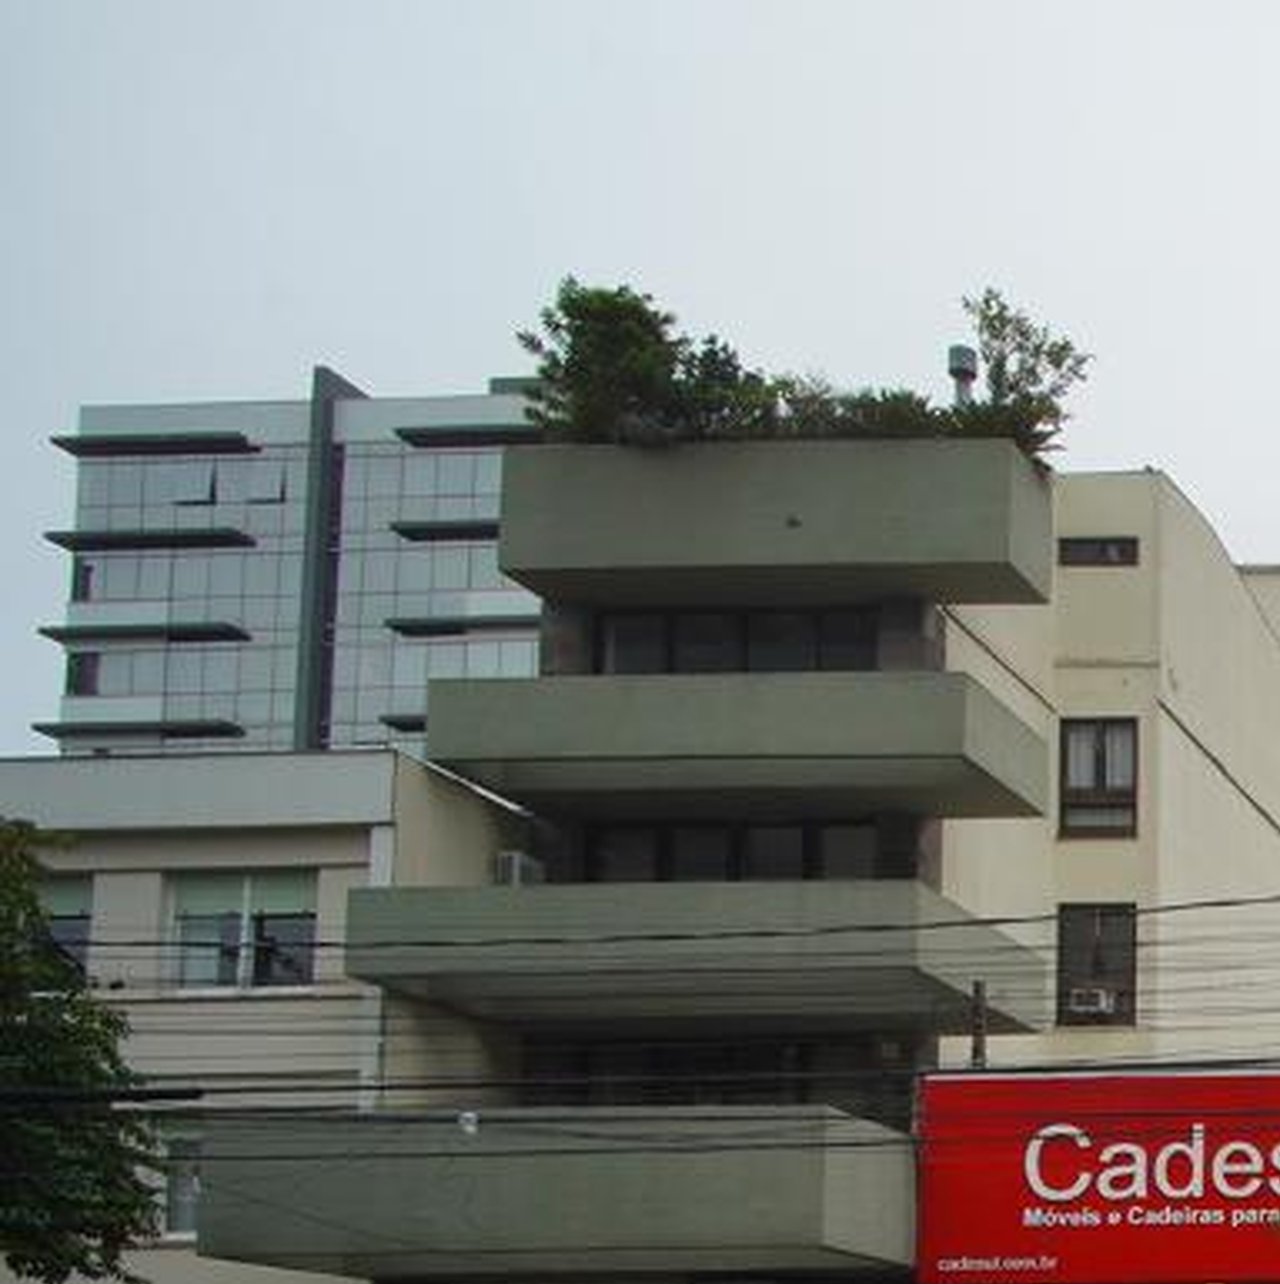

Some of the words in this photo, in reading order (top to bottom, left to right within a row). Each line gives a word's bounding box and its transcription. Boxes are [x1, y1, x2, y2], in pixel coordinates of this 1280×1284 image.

[1023, 1205, 1101, 1227] Móveis
[1108, 1209, 1120, 1225] e
[1127, 1205, 1225, 1225] Cadeiras
